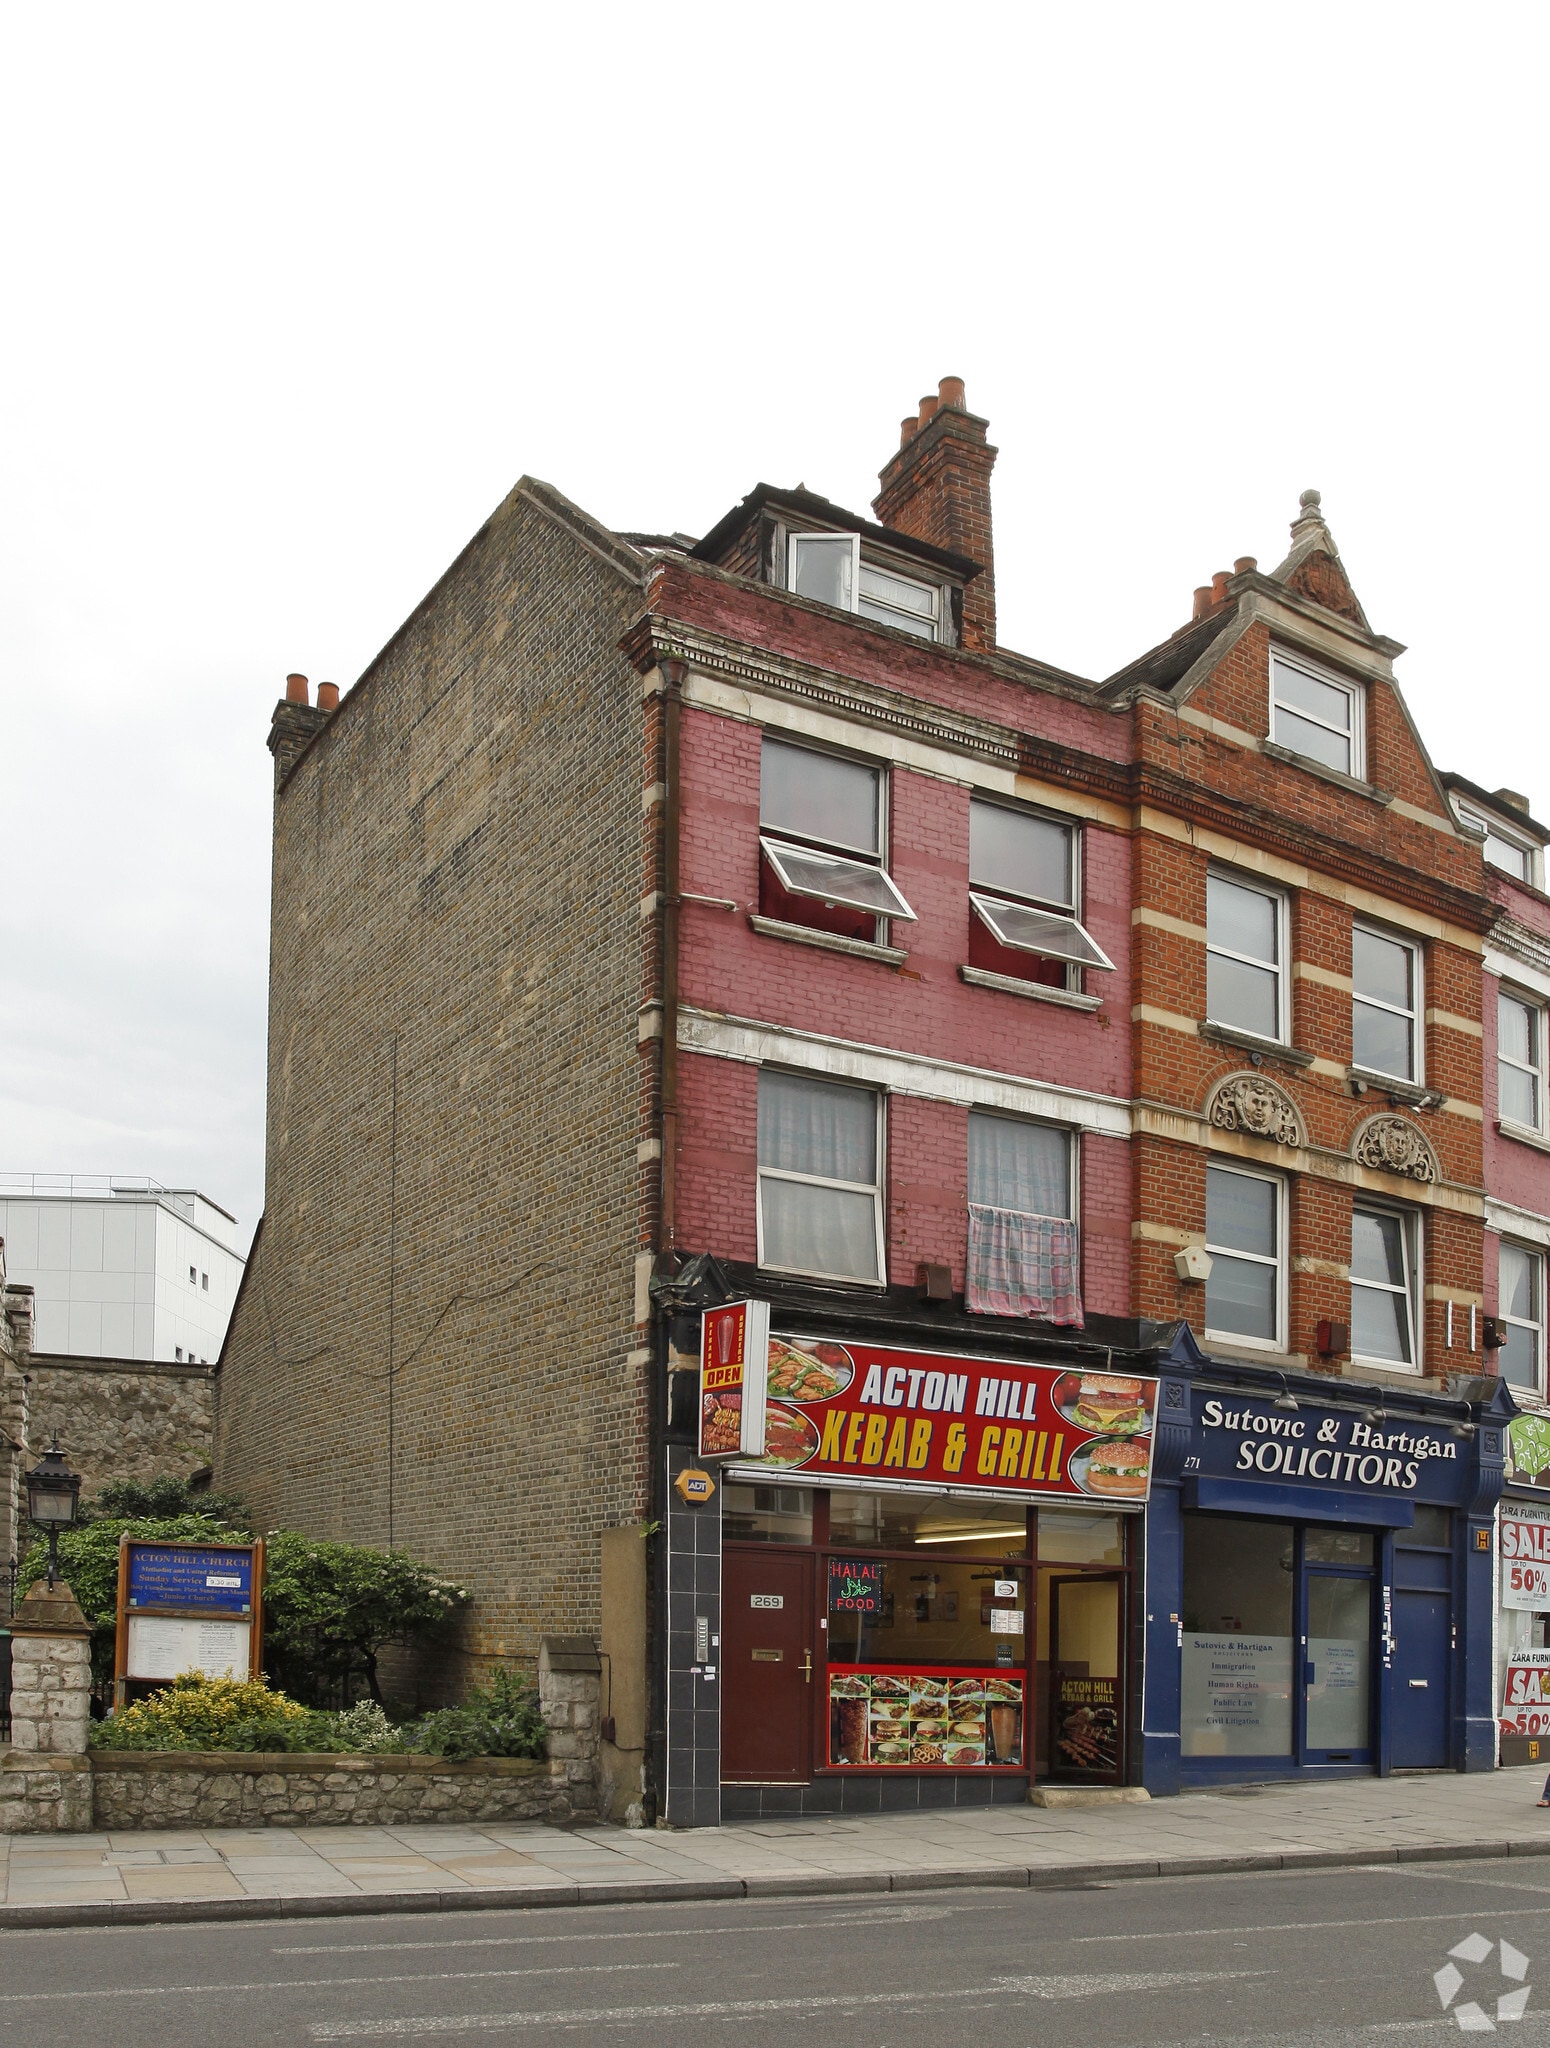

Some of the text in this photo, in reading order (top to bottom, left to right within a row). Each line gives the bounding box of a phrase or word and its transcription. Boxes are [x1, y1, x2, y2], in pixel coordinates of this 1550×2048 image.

[706, 1366, 741, 1386] OPEN
[859, 1364, 1037, 1421] ACTON HILL
[1201, 1400, 1458, 1461] Sutovic & Hartigan
[819, 1409, 1065, 1483] KEBAB & GRILL
[1184, 1456, 1200, 1469] 271
[1236, 1440, 1420, 1490] SOLICITORS
[688, 1481, 707, 1491] ADT
[1503, 1522, 1550, 1561] SALE
[134, 1553, 249, 1568] ACTON HILL CHURCH
[832, 1563, 879, 1580] HALAL
[138, 1574, 169, 1584] Sunday
[172, 1576, 203, 1585] Service
[1511, 1567, 1547, 1593] 50%
[755, 1596, 780, 1607] 269
[836, 1597, 875, 1610] FOOD
[1194, 1641, 1273, 1652] Sutovic & Hartigan
[1511, 1653, 1531, 1662] ZARA
[1211, 1662, 1256, 1671] Immigration
[1061, 1681, 1114, 1694] ACTON HILL
[1208, 1680, 1259, 1690] Human Rights
[1093, 1694, 1114, 1703] GRILL
[1226, 1717, 1260, 1726] Litigation
